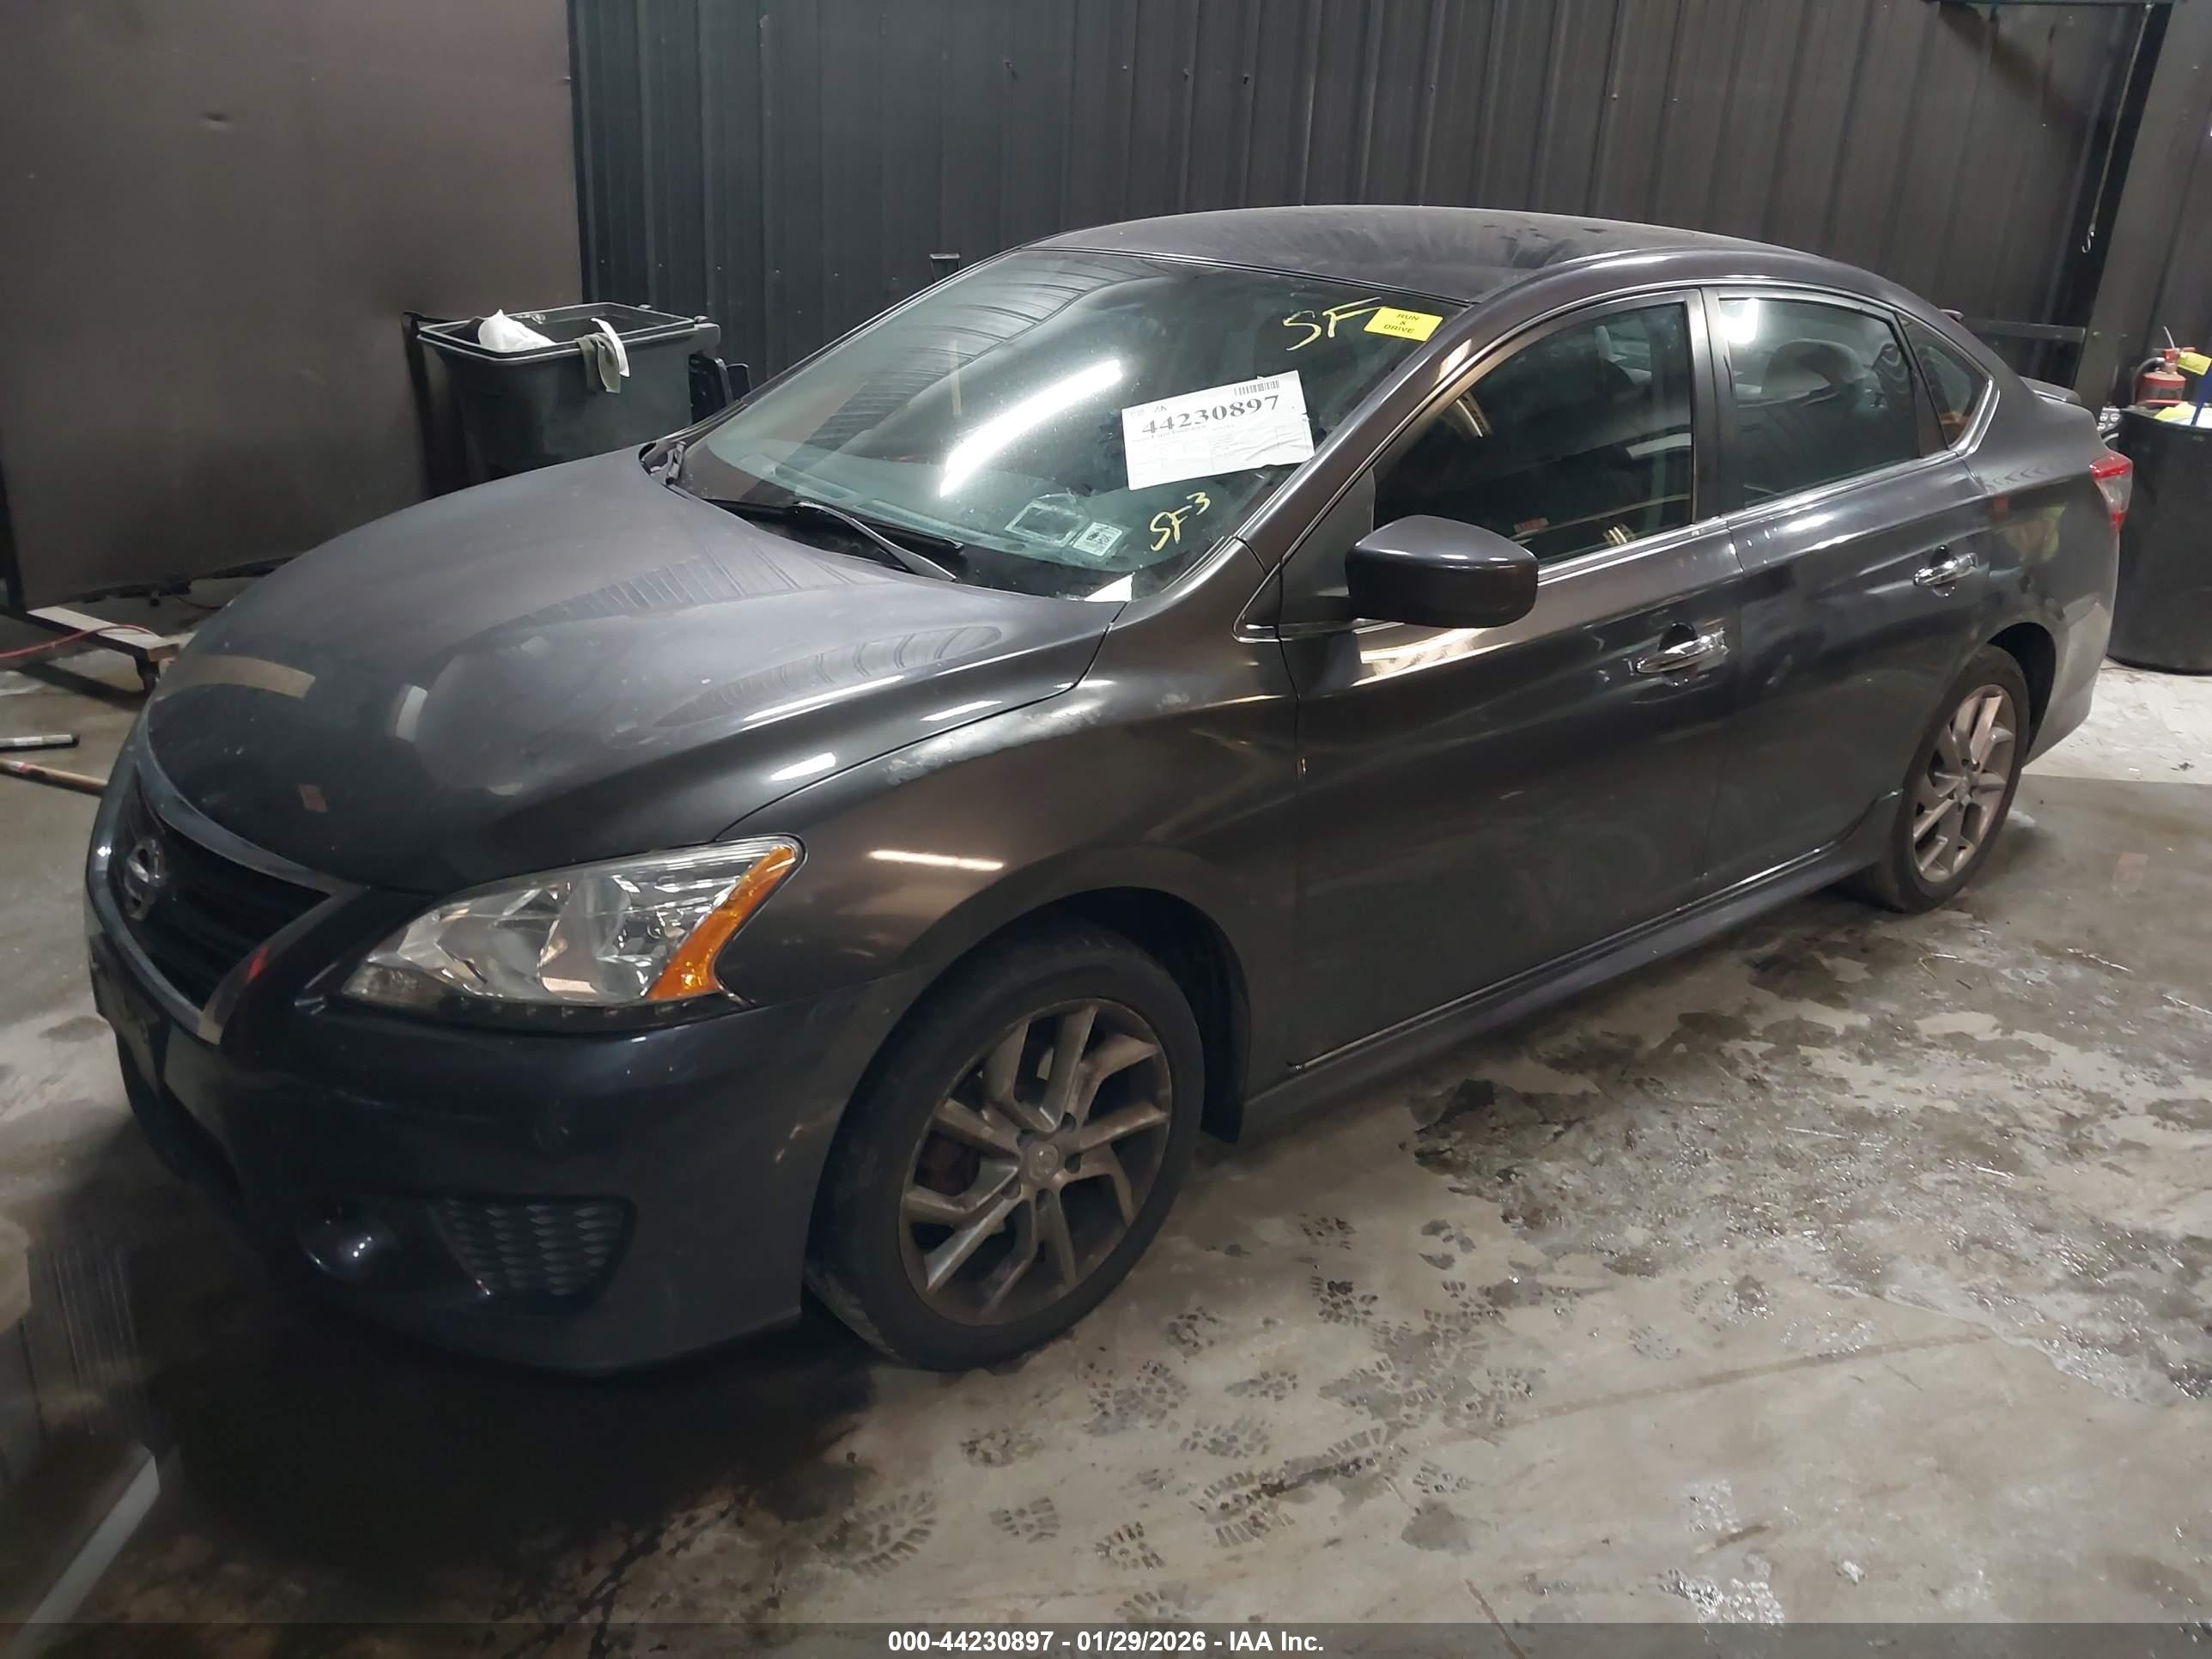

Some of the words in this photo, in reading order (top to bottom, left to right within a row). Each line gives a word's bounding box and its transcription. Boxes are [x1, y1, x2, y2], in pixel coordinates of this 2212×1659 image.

[1282, 297, 1382, 351] SF
[1383, 324, 1415, 333] DRIVE
[1142, 394, 1279, 434] 44230897
